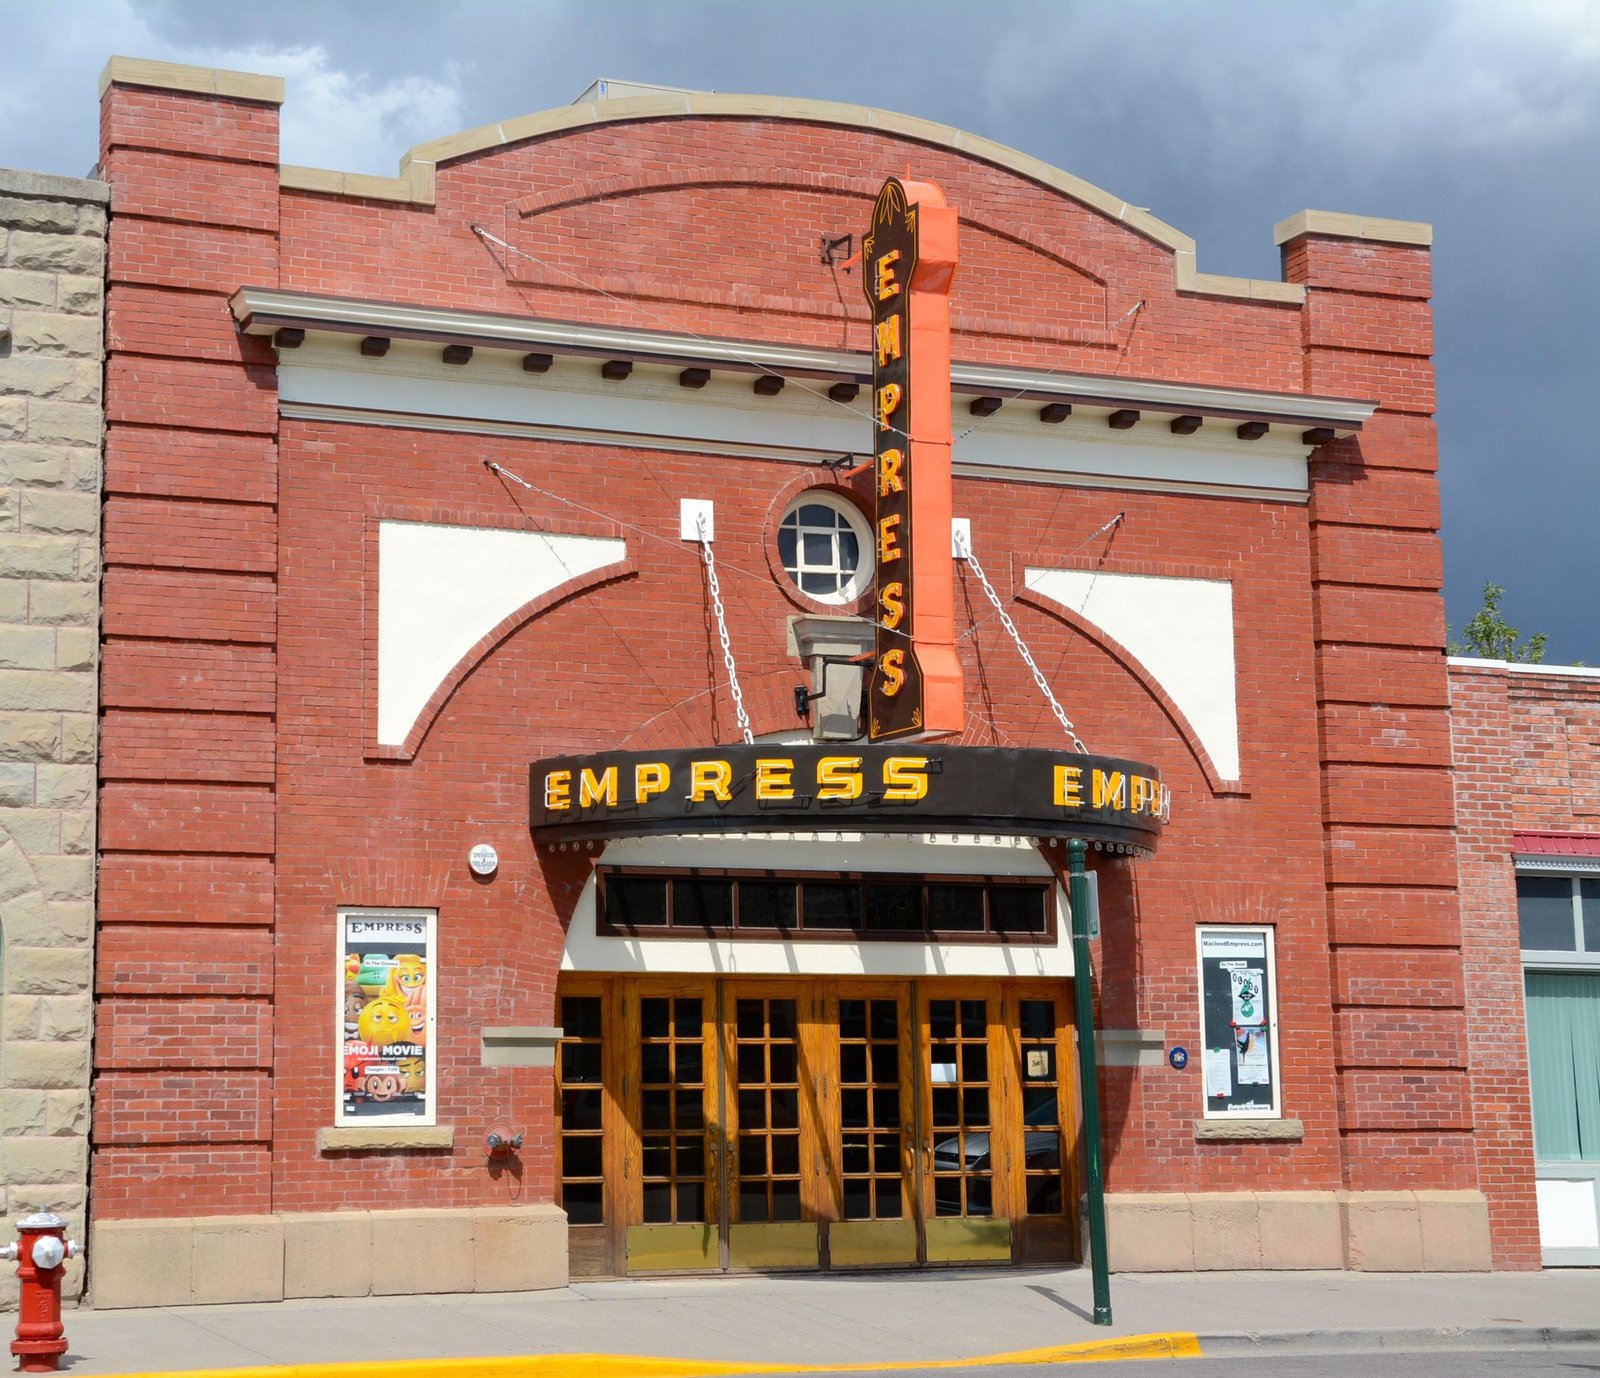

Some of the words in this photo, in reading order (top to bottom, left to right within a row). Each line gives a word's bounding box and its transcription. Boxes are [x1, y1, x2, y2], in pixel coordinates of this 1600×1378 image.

[875, 249, 905, 697] EMPRESS
[545, 756, 930, 810] EMPRESS
[351, 922, 423, 934] EMPRESS
[343, 1045, 379, 1056] EMOJI
[382, 1045, 423, 1056] MOVIE
